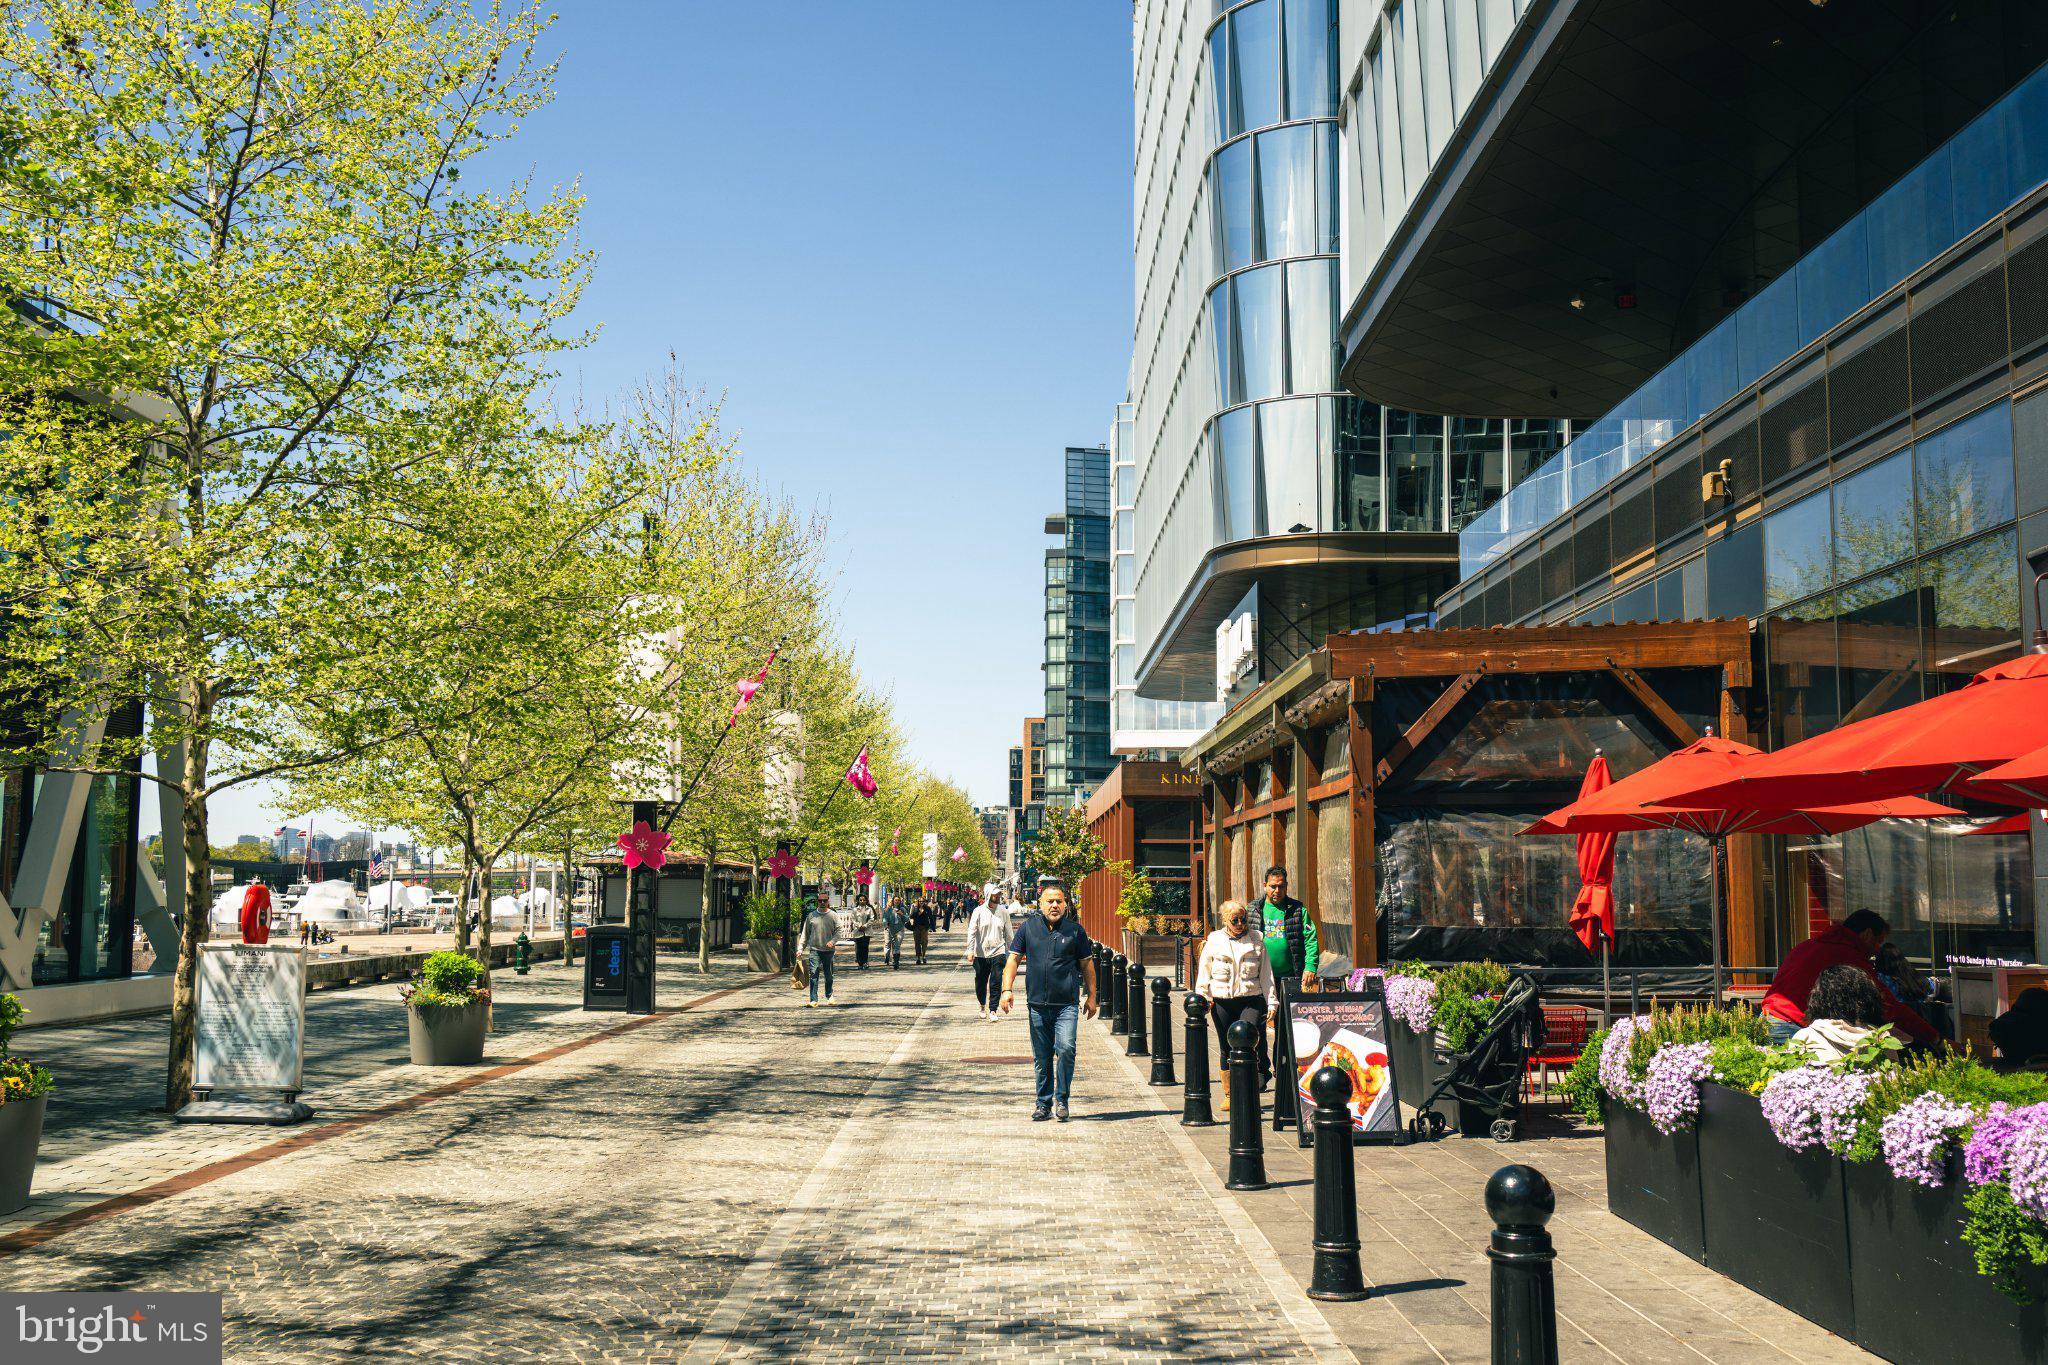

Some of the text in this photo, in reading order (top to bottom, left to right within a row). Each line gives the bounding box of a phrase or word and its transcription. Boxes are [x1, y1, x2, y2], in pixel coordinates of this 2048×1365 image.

[608, 940, 620, 976] clean
[1945, 954, 2023, 967] 11 to 10 Sunday thru Thursday
[1297, 1005, 1333, 1014] LOBSTER,
[1315, 1014, 1340, 1022] CHIPS
[1341, 1013, 1375, 1022] COMBO
